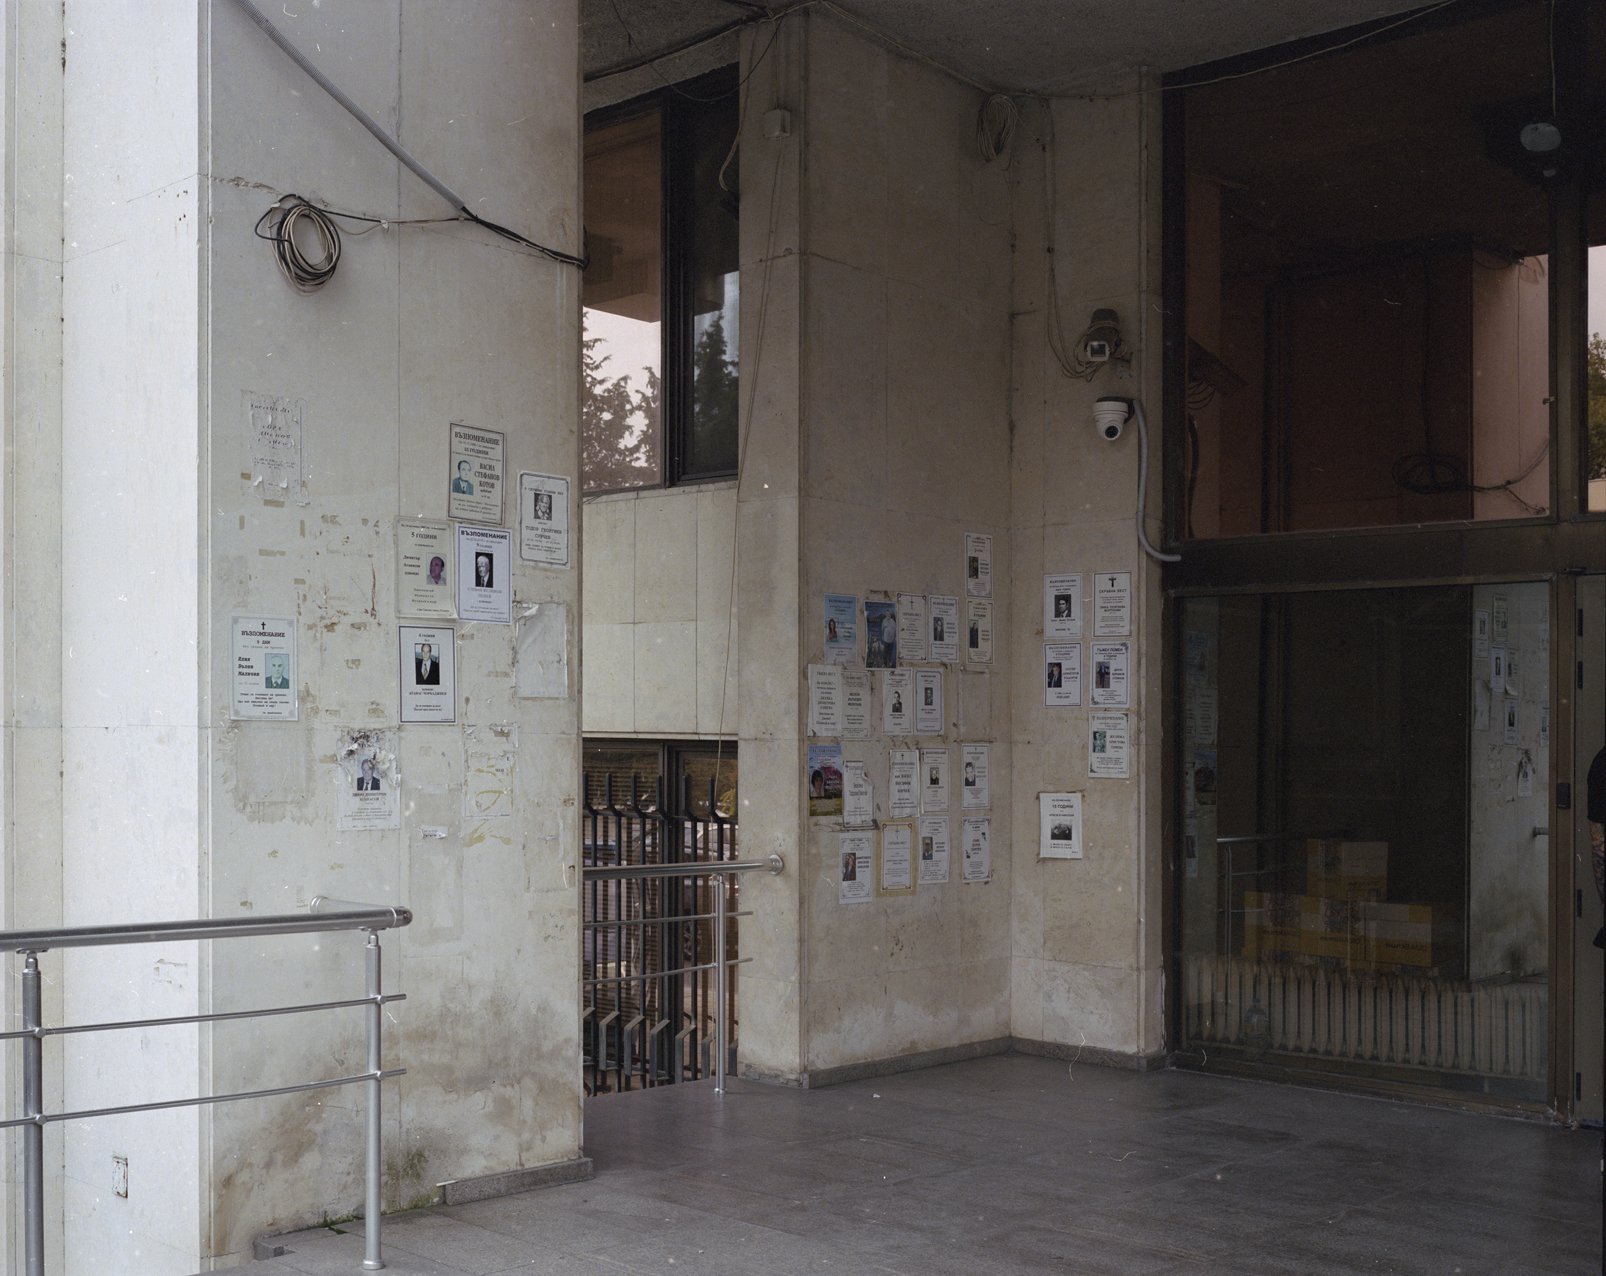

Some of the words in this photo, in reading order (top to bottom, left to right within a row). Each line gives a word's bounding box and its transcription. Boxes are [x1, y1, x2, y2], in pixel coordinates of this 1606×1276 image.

[455, 431, 500, 446] ВЪЗПОМЕНАНИЕ
[480, 463, 495, 471] ВАСИЛ
[474, 471, 500, 481] СТЕФАНОВ
[461, 530, 508, 540] ВЪЗПОМЕНАНИЕ
